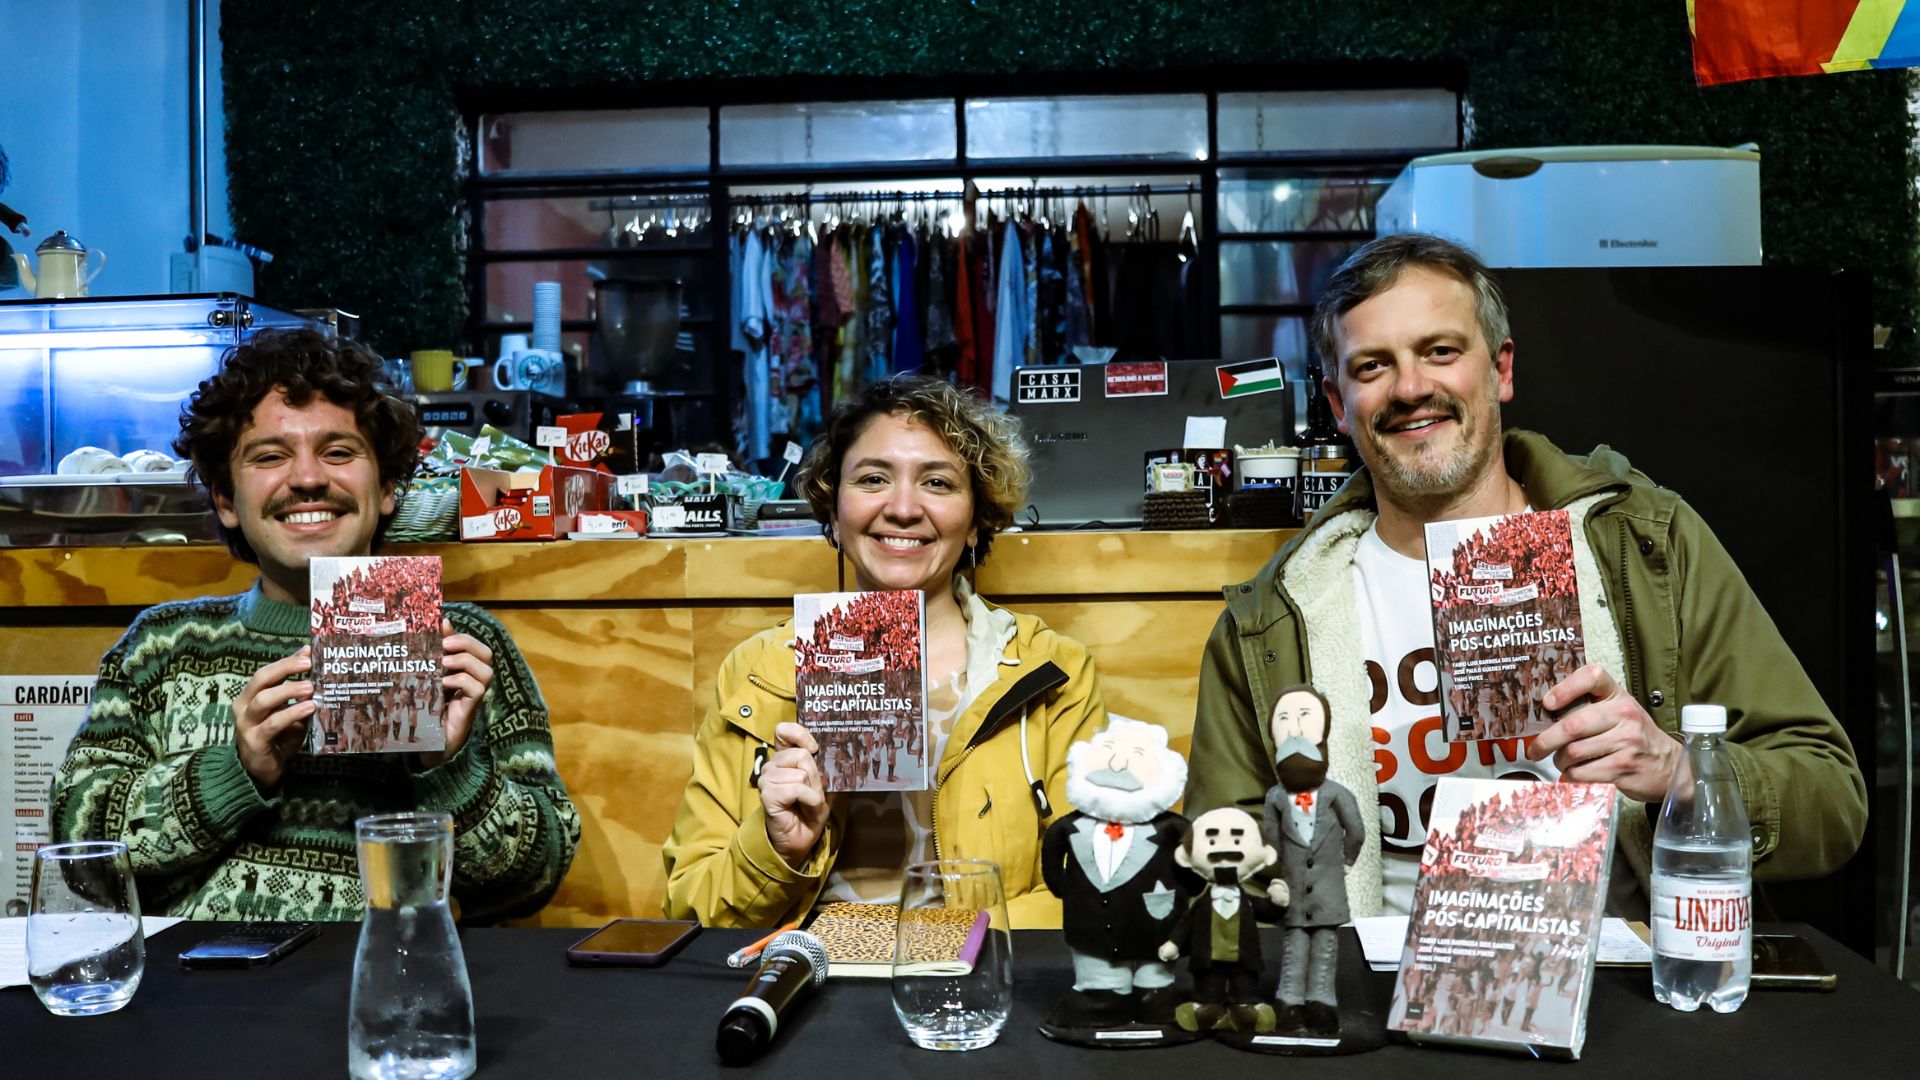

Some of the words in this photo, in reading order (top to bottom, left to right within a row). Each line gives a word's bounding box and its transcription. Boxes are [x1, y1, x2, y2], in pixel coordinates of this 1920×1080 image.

[1028, 373, 1071, 386] CASA
[1027, 386, 1072, 399] MARX
[570, 431, 608, 461] KitKat
[1459, 586, 1500, 597] FUTURO
[336, 618, 372, 626] FUTURO
[1448, 611, 1543, 635] IMAGINAÇÕES
[1450, 627, 1575, 652] PÓS-CAPITALISTAS
[323, 643, 409, 661] IMAGINAÇÕES
[817, 656, 852, 664] FUTURO
[323, 659, 436, 675] PÓS-CAPITALISTAS
[805, 681, 886, 699] IMAGINAÇÕES
[805, 697, 912, 713] PÓS-CAPITALISTAS
[1454, 854, 1502, 866] FUTURO
[1428, 890, 1545, 913] IMAGINAÇÕES
[1424, 907, 1581, 937] PÓS-CAPITALISTAS
[1675, 895, 1751, 933] LINDOYA
[1695, 934, 1741, 950] Original
